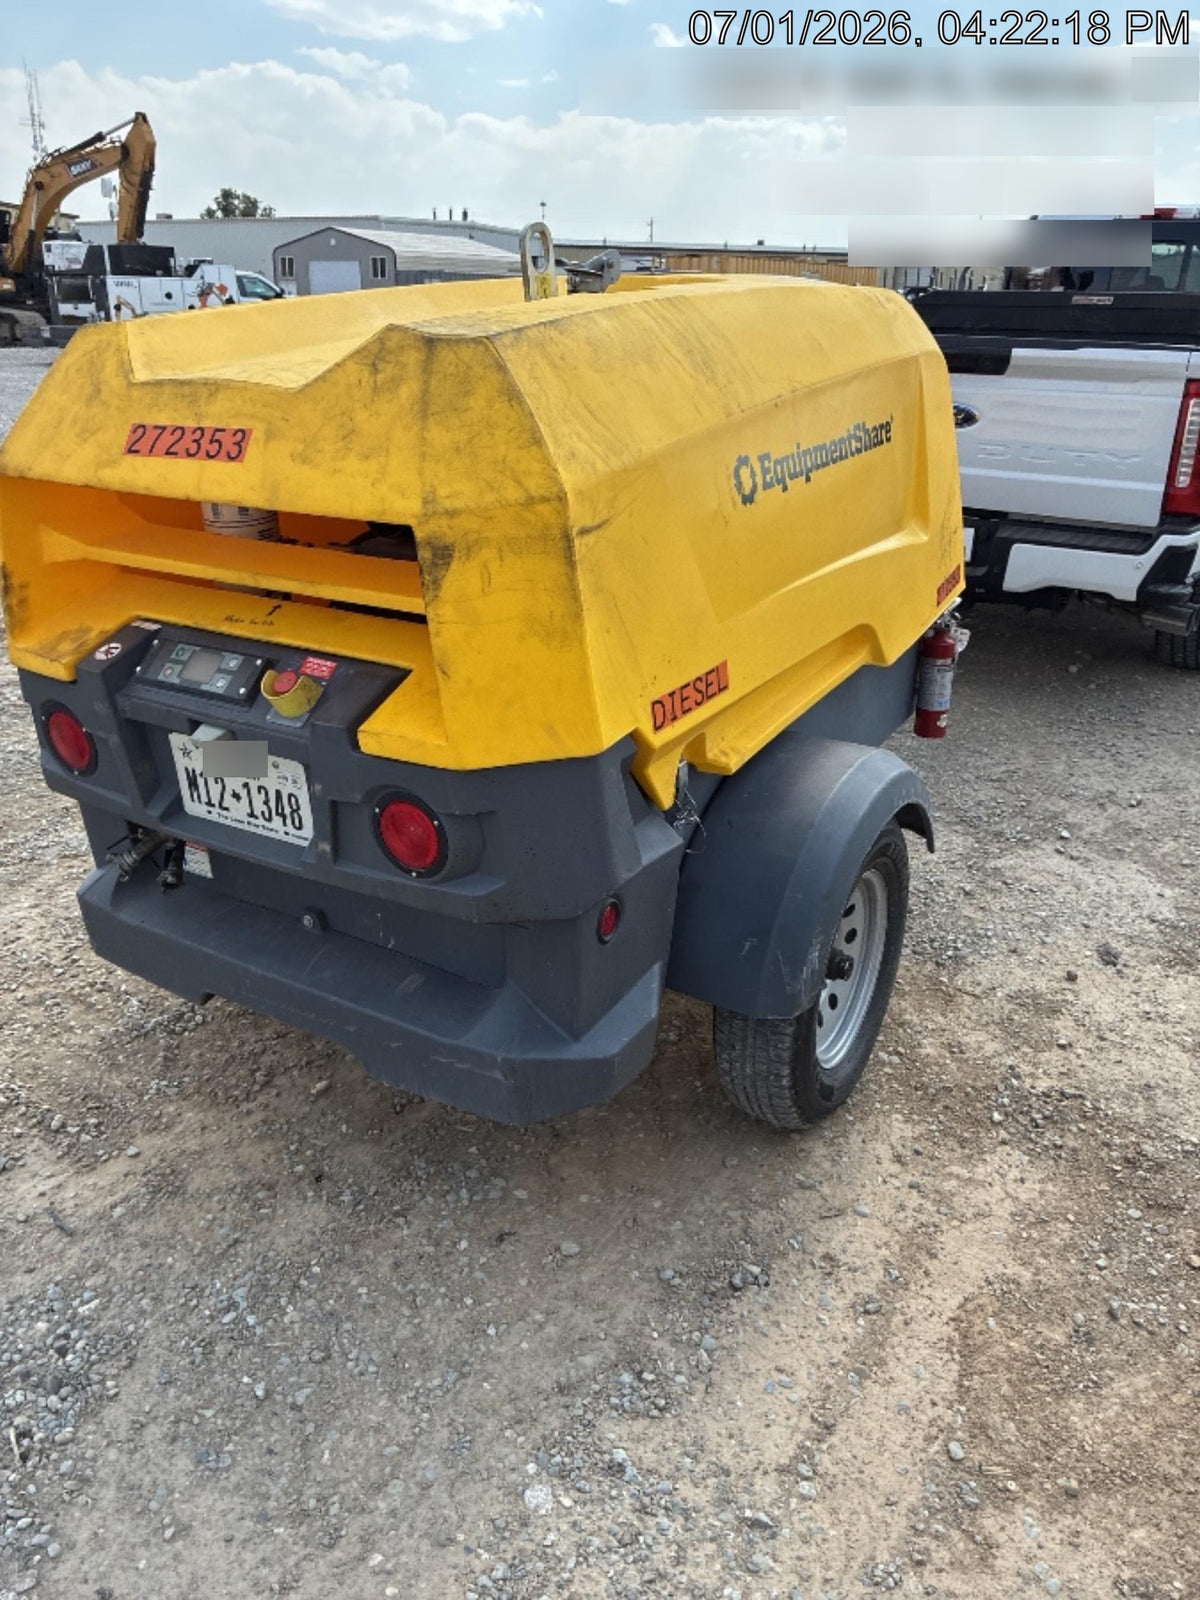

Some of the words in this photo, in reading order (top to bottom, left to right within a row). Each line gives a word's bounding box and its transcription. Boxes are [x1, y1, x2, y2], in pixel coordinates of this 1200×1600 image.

[127, 424, 246, 460] 272353
[757, 420, 892, 493] EquipmentShare
[652, 666, 728, 731] DIESEL
